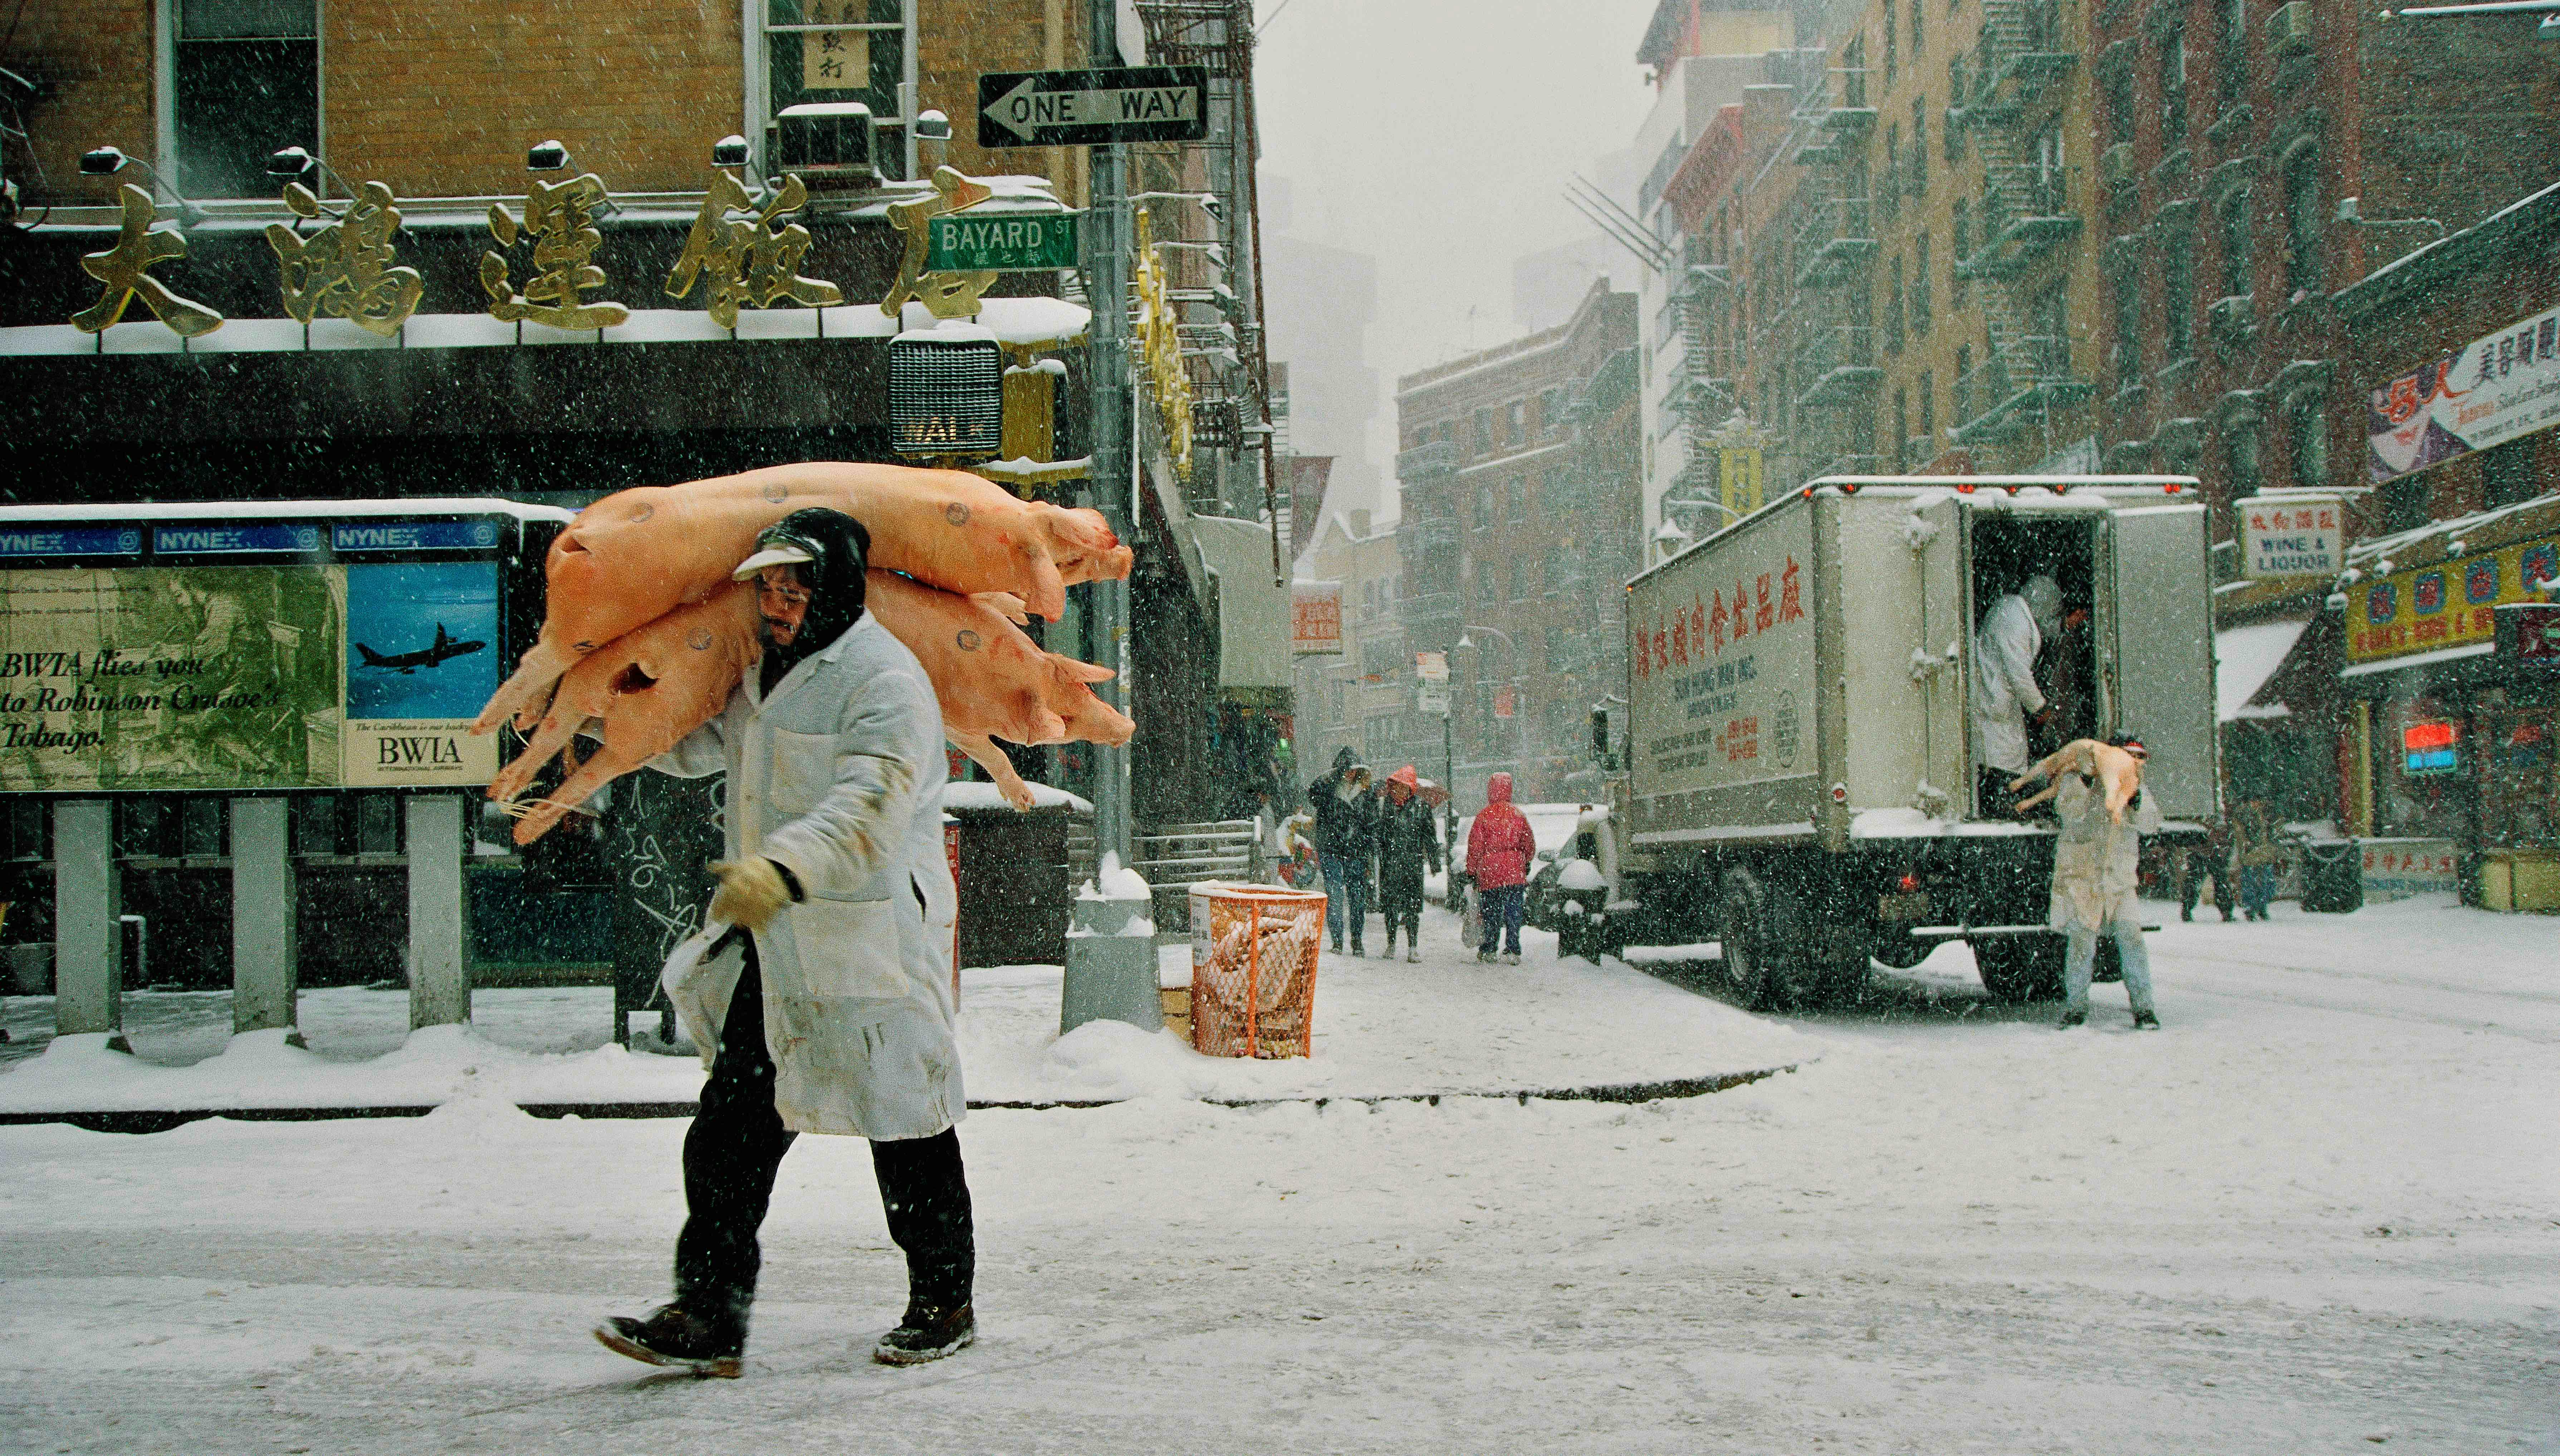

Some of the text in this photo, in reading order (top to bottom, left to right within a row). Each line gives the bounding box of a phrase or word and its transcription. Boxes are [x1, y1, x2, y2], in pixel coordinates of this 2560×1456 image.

[1011, 89, 1188, 124] ONE WAY
[942, 220, 1071, 251] BAYARD ST
[160, 531, 243, 549] NYNEX
[2261, 537, 2325, 552] WINE &
[2259, 554, 2330, 571] LIQUOR
[1, 649, 204, 683] BWIA flies you
[0, 682, 279, 713] to Robinson Crusoe's
[1, 721, 106, 755] Tobago.
[377, 737, 464, 764] BWIA
